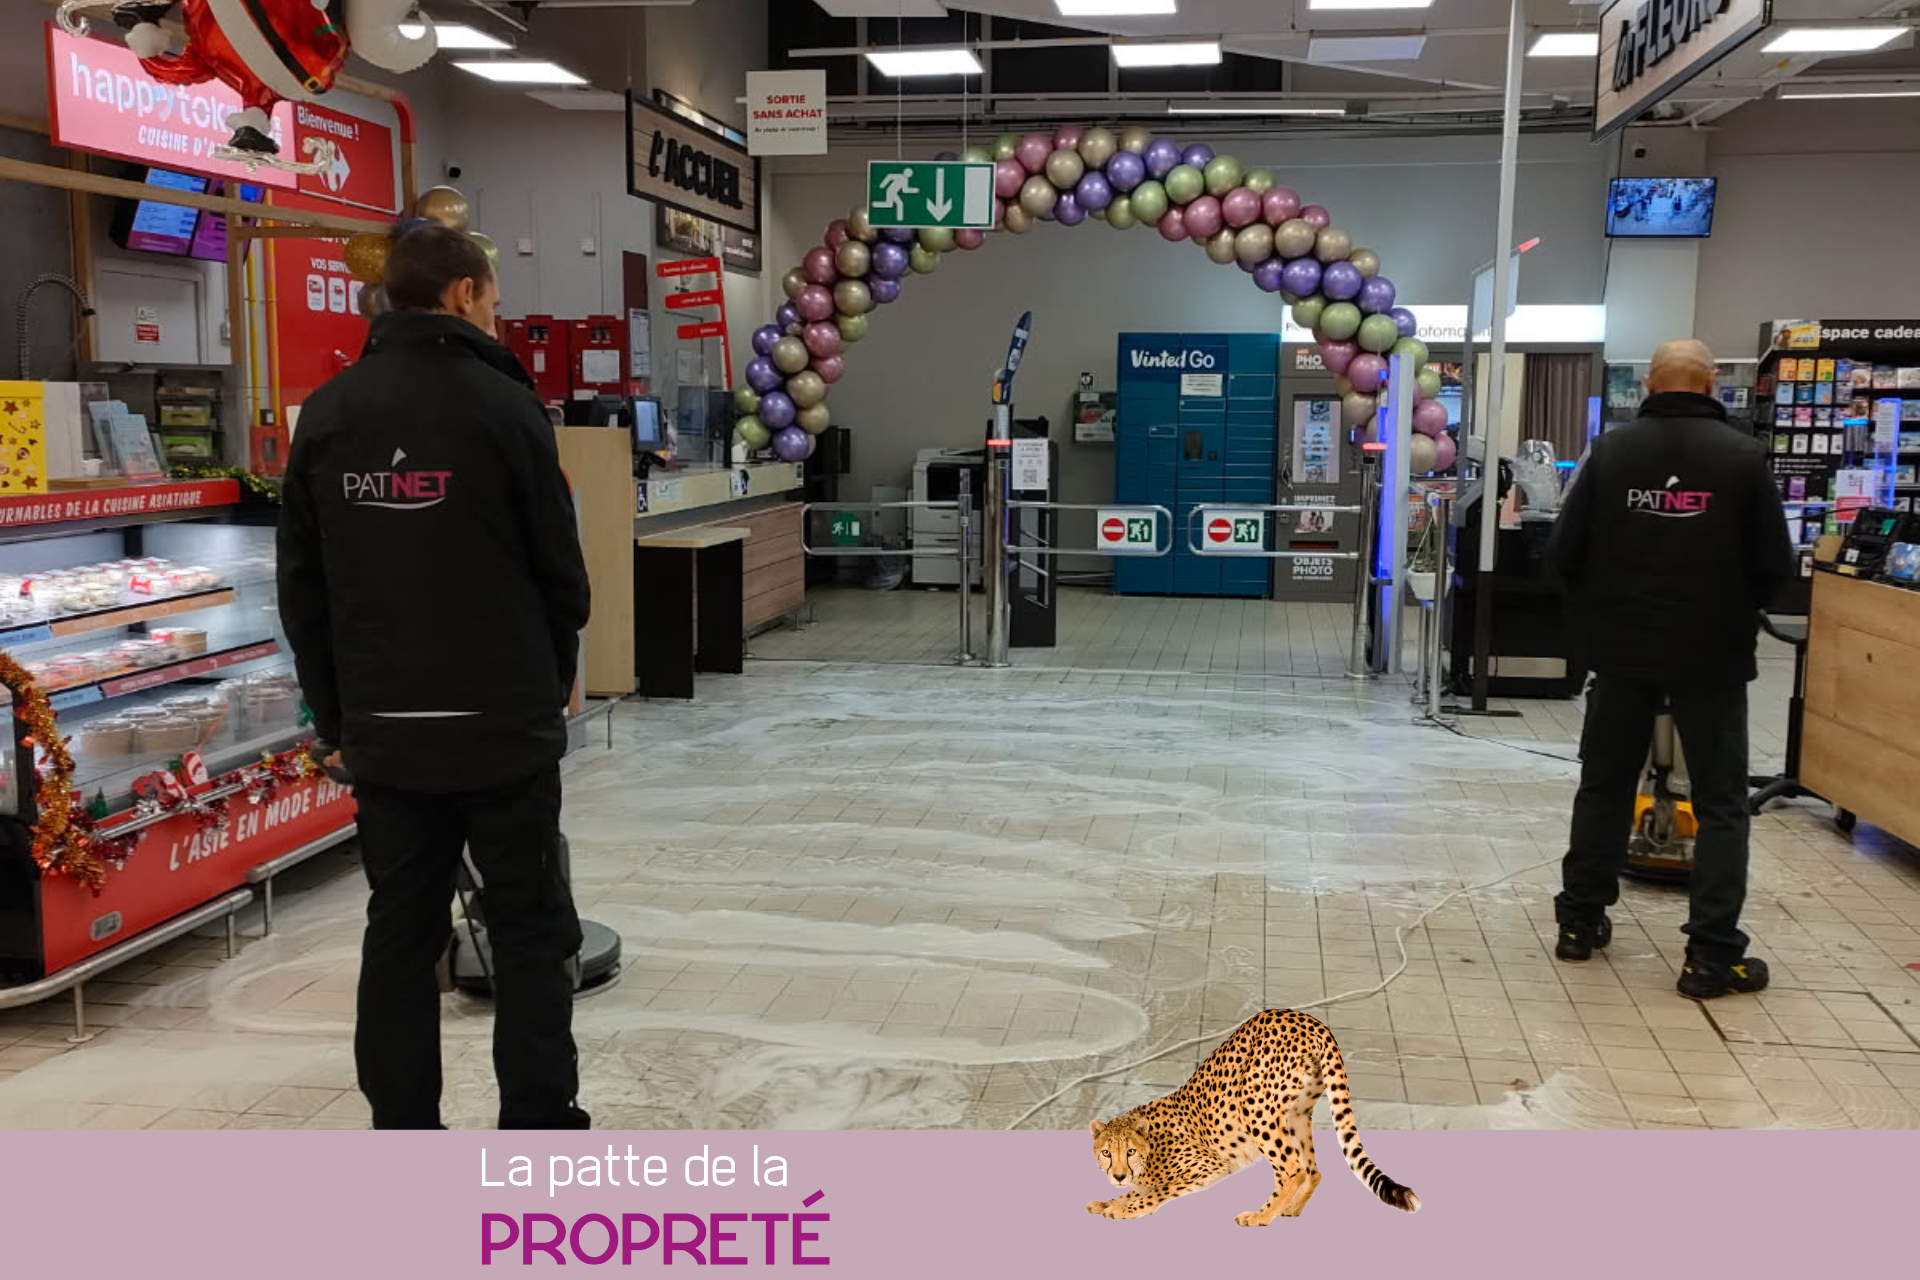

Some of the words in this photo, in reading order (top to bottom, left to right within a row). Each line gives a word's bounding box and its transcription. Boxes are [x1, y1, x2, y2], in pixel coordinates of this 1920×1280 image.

[766, 94, 806, 104] SORTIE
[753, 109, 783, 119] SANS
[785, 108, 823, 119] ACHAT
[138, 125, 189, 153] CUISINE
[1130, 350, 1187, 369] Vinted
[1189, 350, 1215, 368] Go
[1295, 354, 1323, 366] PHO
[66, 501, 82, 517] DE
[84, 499, 100, 516] LA
[103, 495, 146, 513] CUISINE
[149, 490, 202, 509] ASIATIQUE
[1292, 556, 1334, 566] OBJETS
[1292, 565, 1334, 575] PHOTO
[169, 831, 230, 871] L'ASIE
[235, 810, 260, 842] EN
[264, 787, 313, 830] MODE
